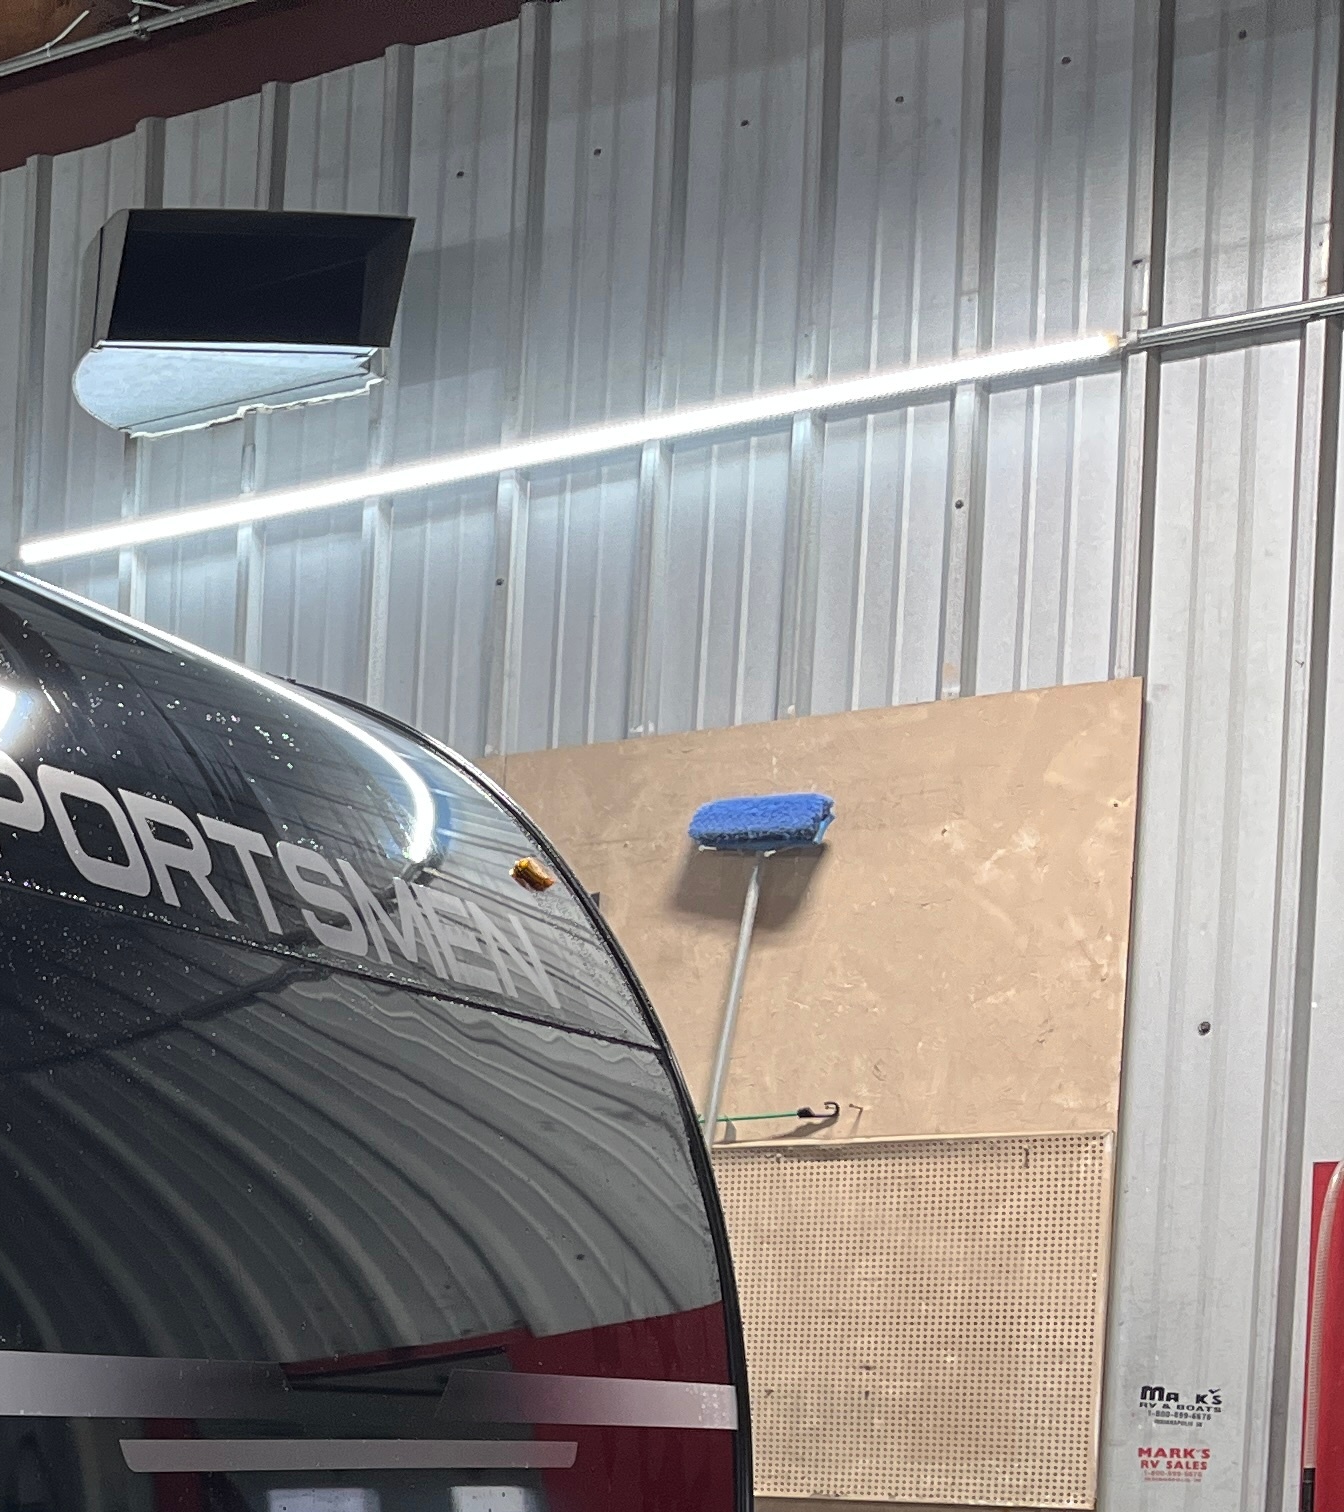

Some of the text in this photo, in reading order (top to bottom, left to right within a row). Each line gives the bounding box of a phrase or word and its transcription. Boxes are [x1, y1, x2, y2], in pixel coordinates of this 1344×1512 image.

[1138, 1447, 1211, 1459] MARK'S
[1140, 1460, 1207, 1470] RV SALES
